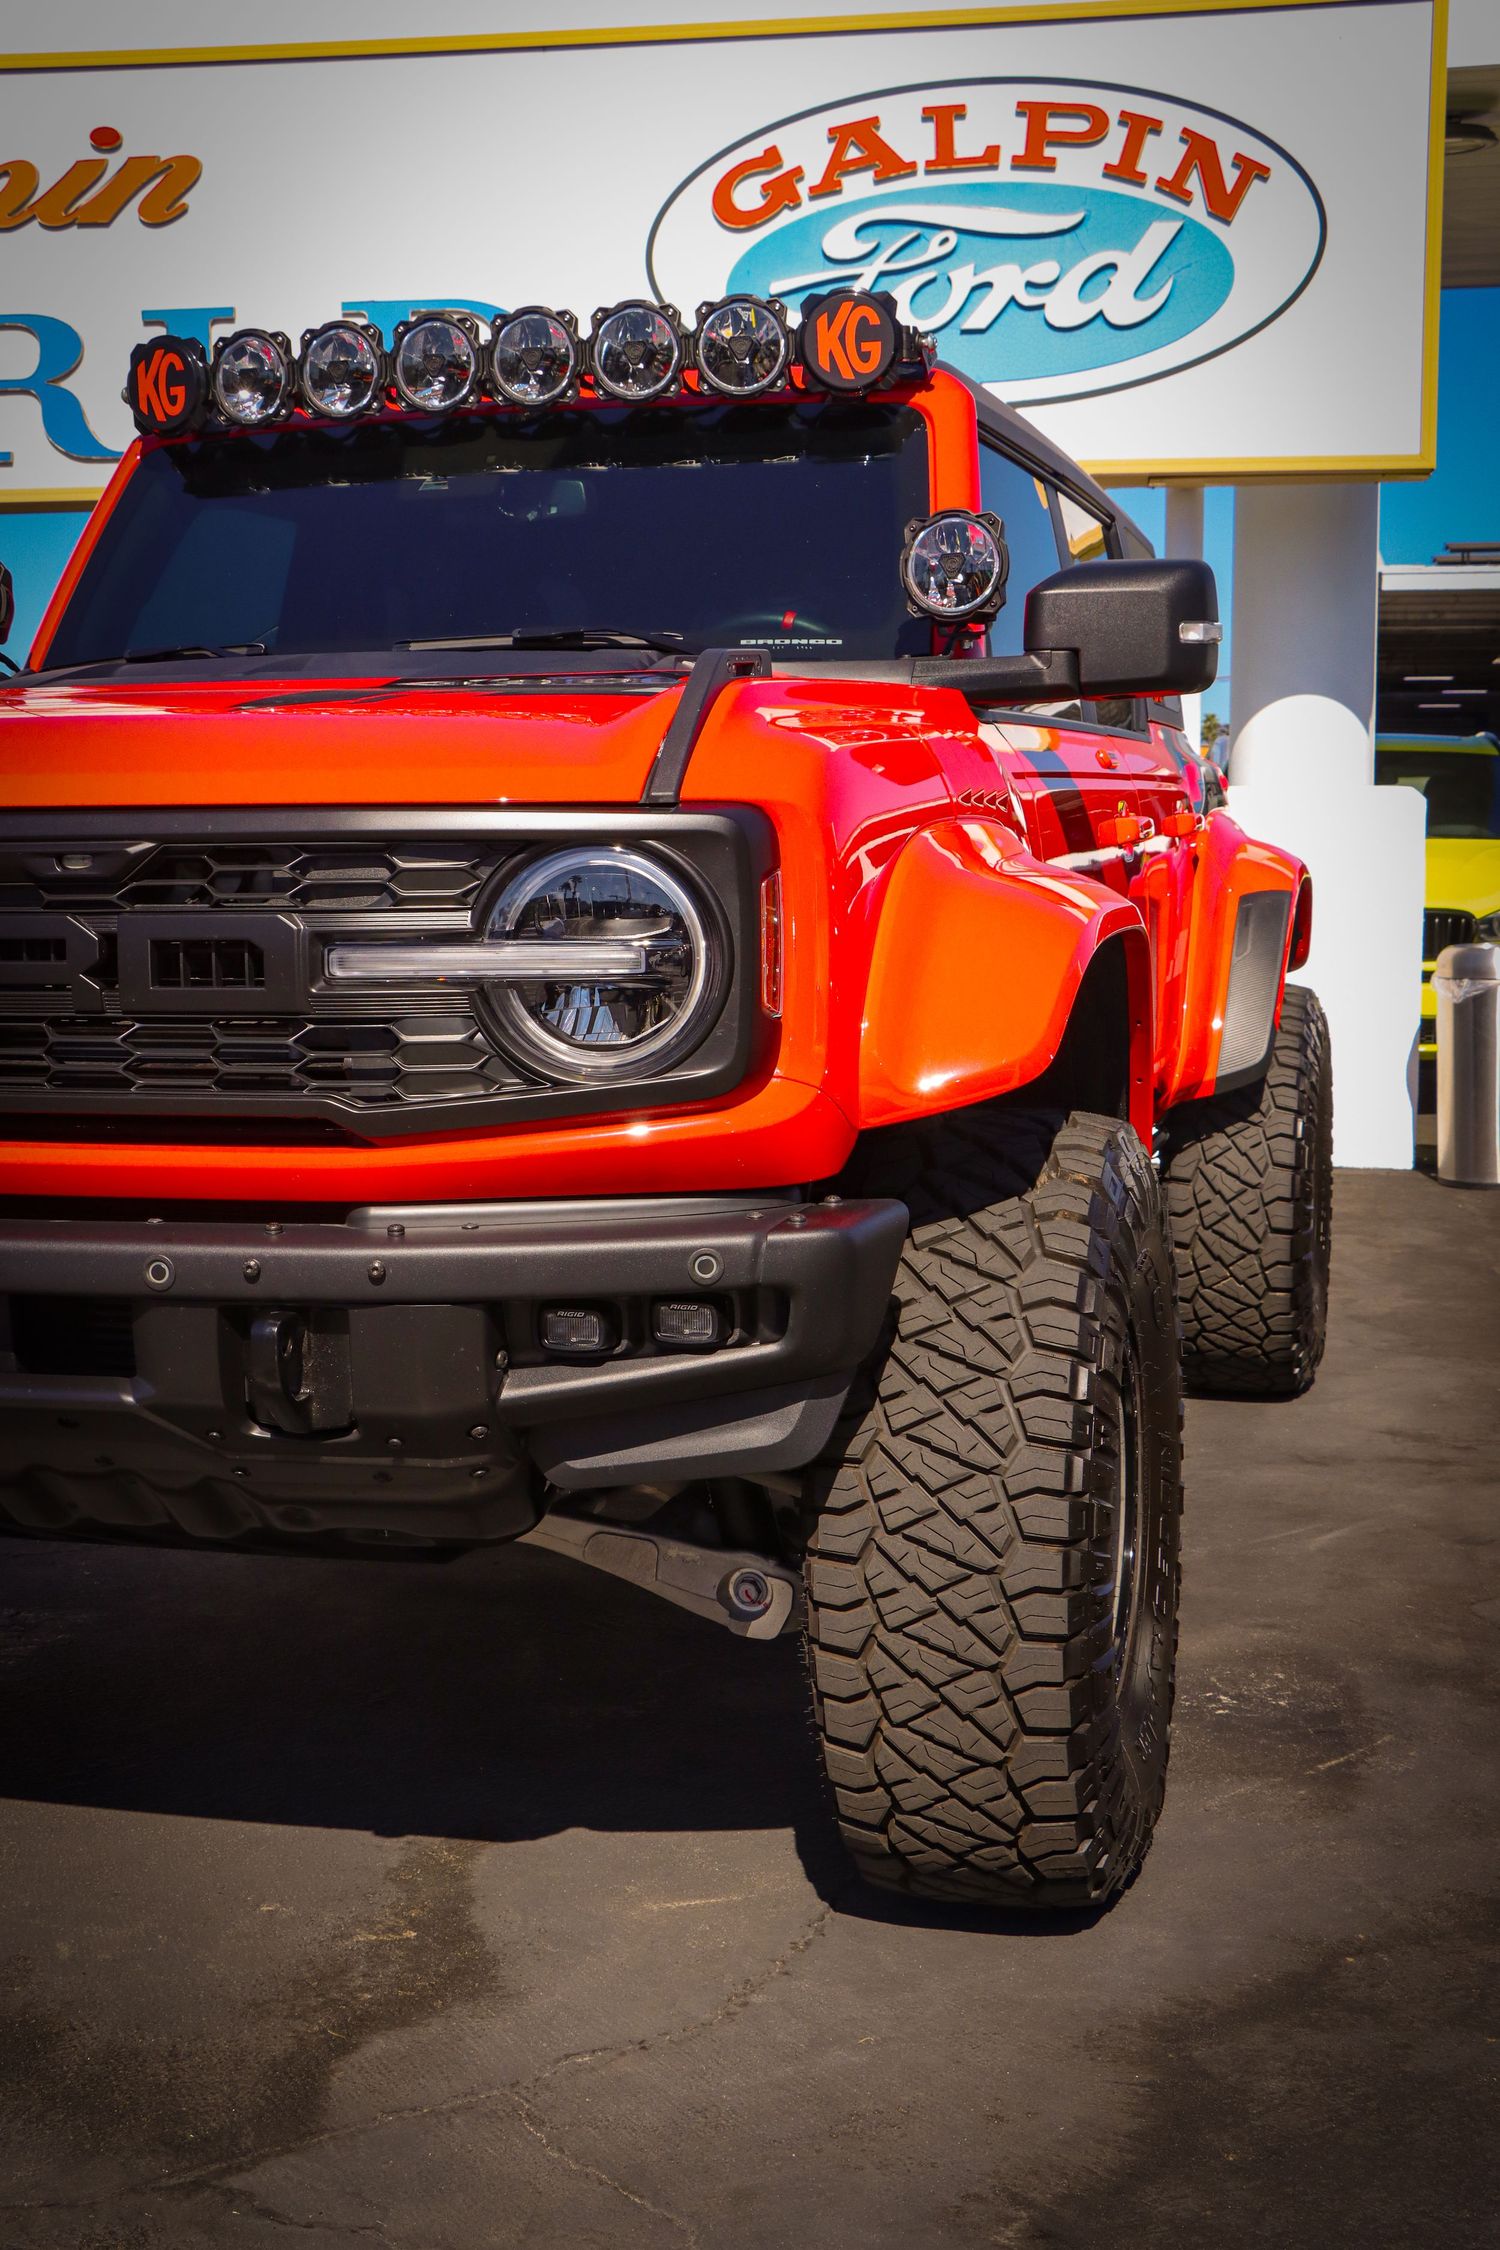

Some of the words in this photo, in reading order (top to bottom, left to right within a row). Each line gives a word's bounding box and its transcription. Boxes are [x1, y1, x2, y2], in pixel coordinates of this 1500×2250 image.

[711, 100, 1271, 229] GALPIN
[769, 203, 1185, 335] Ford
[556, 1310, 585, 1318] RIGID
[669, 1303, 698, 1311] RIGID
